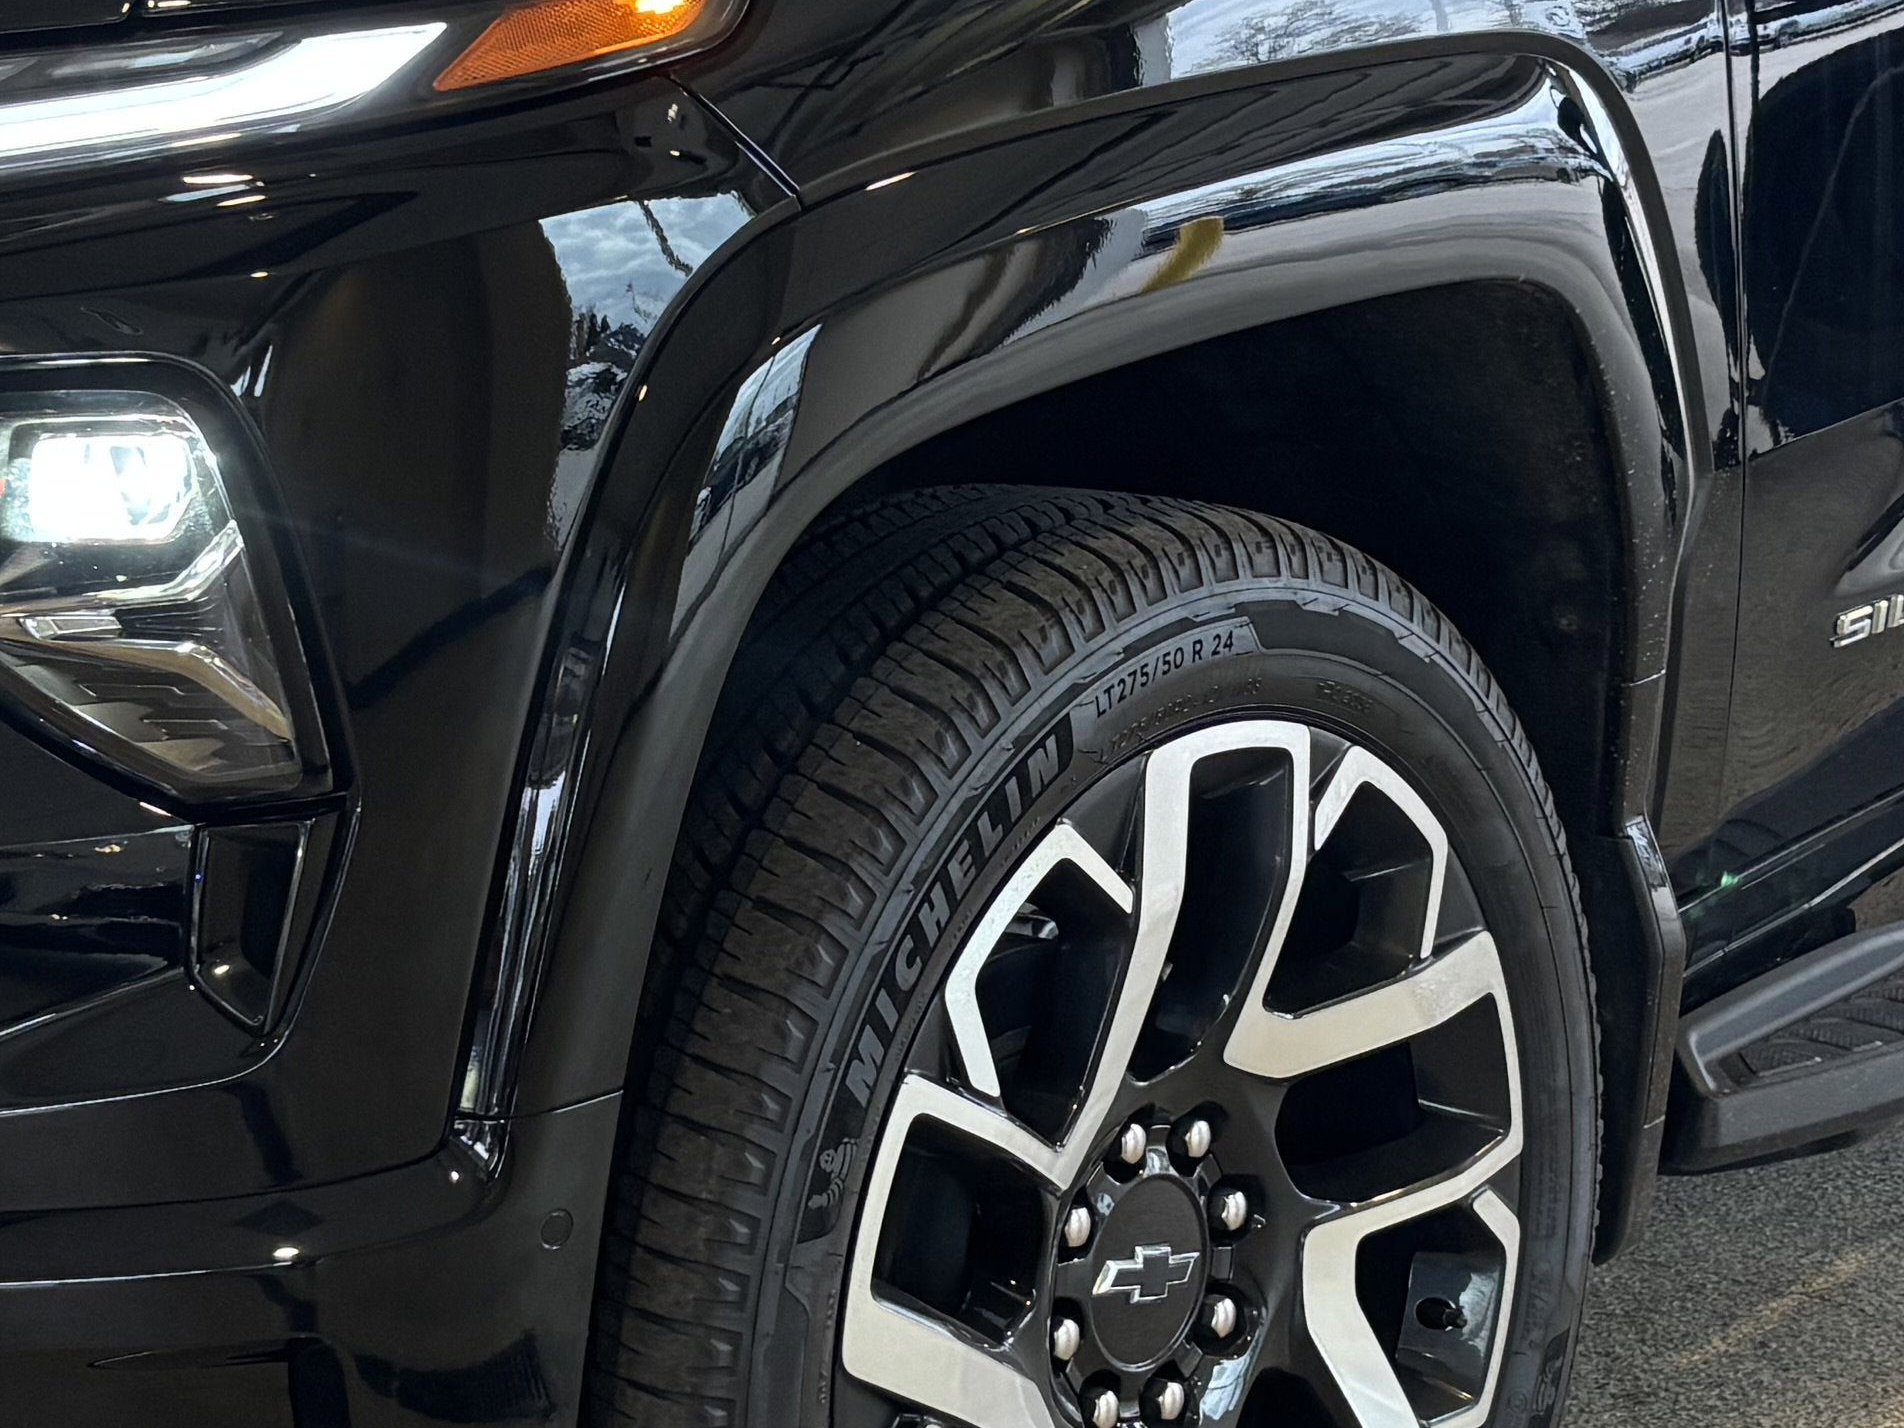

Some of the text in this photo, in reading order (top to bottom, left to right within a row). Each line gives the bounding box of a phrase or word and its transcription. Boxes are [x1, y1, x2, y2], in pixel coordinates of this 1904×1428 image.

[1094, 648, 1185, 719] LT275/50
[1191, 639, 1204, 664] R
[1210, 629, 1235, 657] 24
[839, 728, 1063, 1108] MICHELIN
